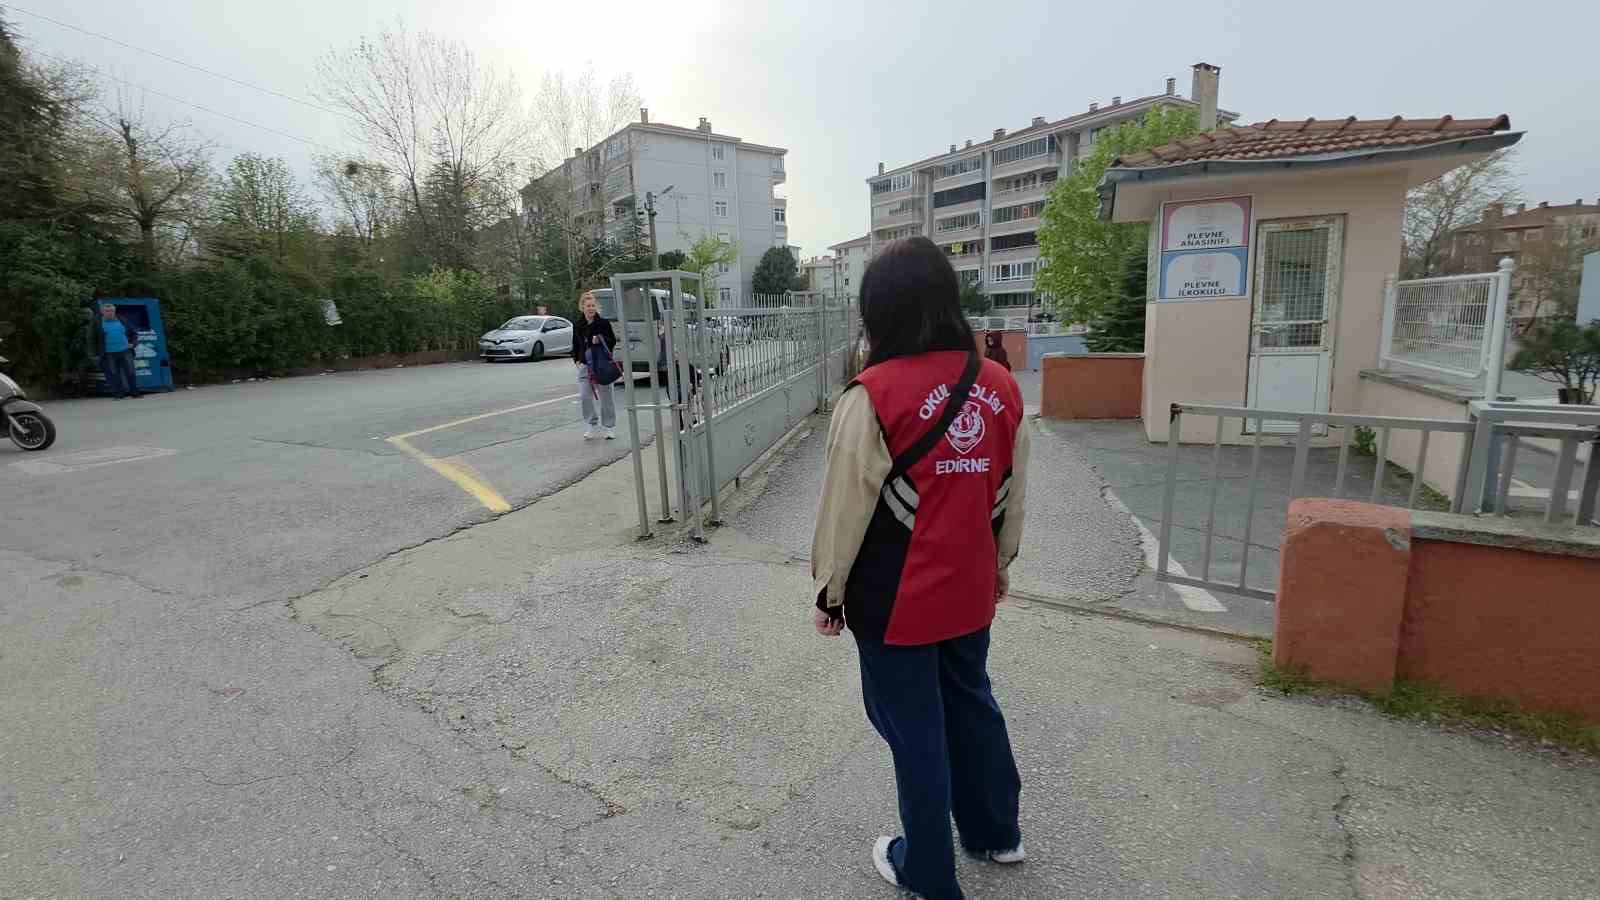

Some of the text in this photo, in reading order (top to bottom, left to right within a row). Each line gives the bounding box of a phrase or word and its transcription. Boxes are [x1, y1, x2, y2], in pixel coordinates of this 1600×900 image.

[1187, 231, 1224, 239] PLEVNE
[1180, 238, 1230, 247] ANASINIFI
[1184, 280, 1221, 288] PLEVNE
[1178, 288, 1225, 297] İLKOKULU
[919, 384, 951, 419] OKUL
[935, 456, 991, 475] EDİRNE
